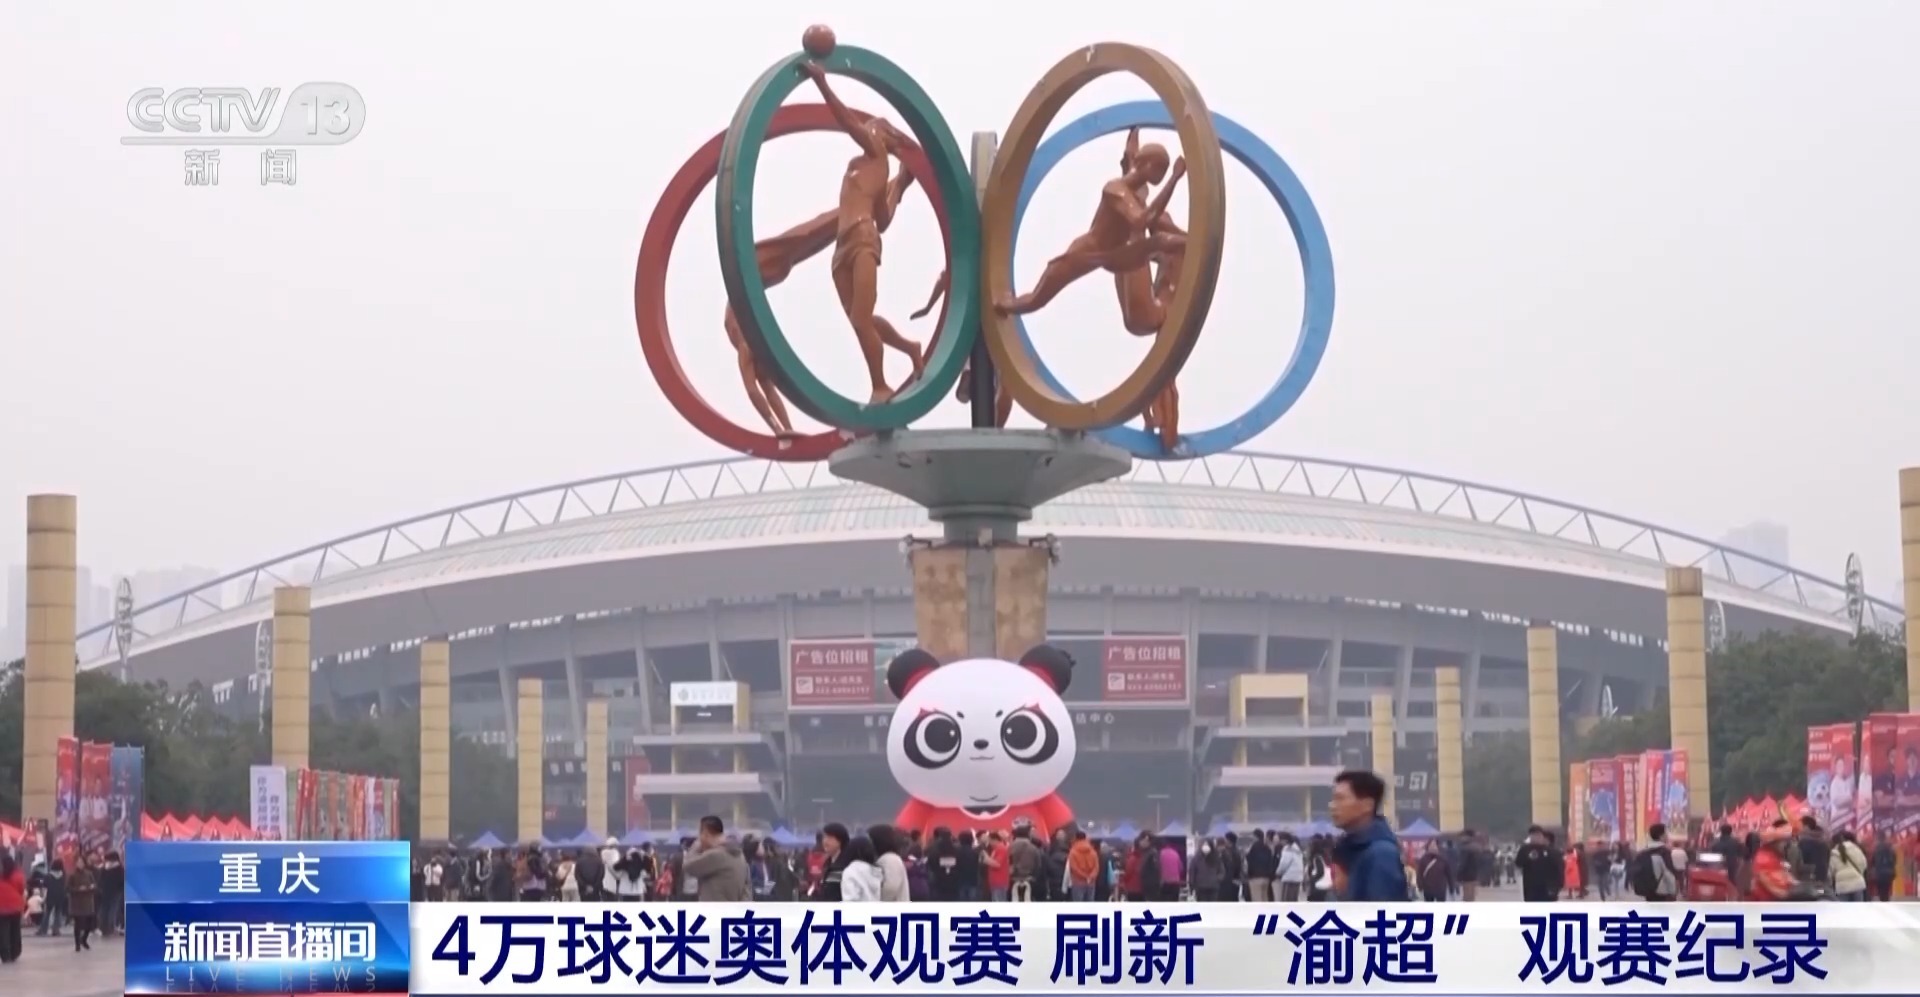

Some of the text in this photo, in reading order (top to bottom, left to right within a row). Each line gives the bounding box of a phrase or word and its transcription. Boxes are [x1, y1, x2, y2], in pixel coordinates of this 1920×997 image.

[795, 649, 869, 665] 广告位招租
[1108, 646, 1181, 661] 广告位招租
